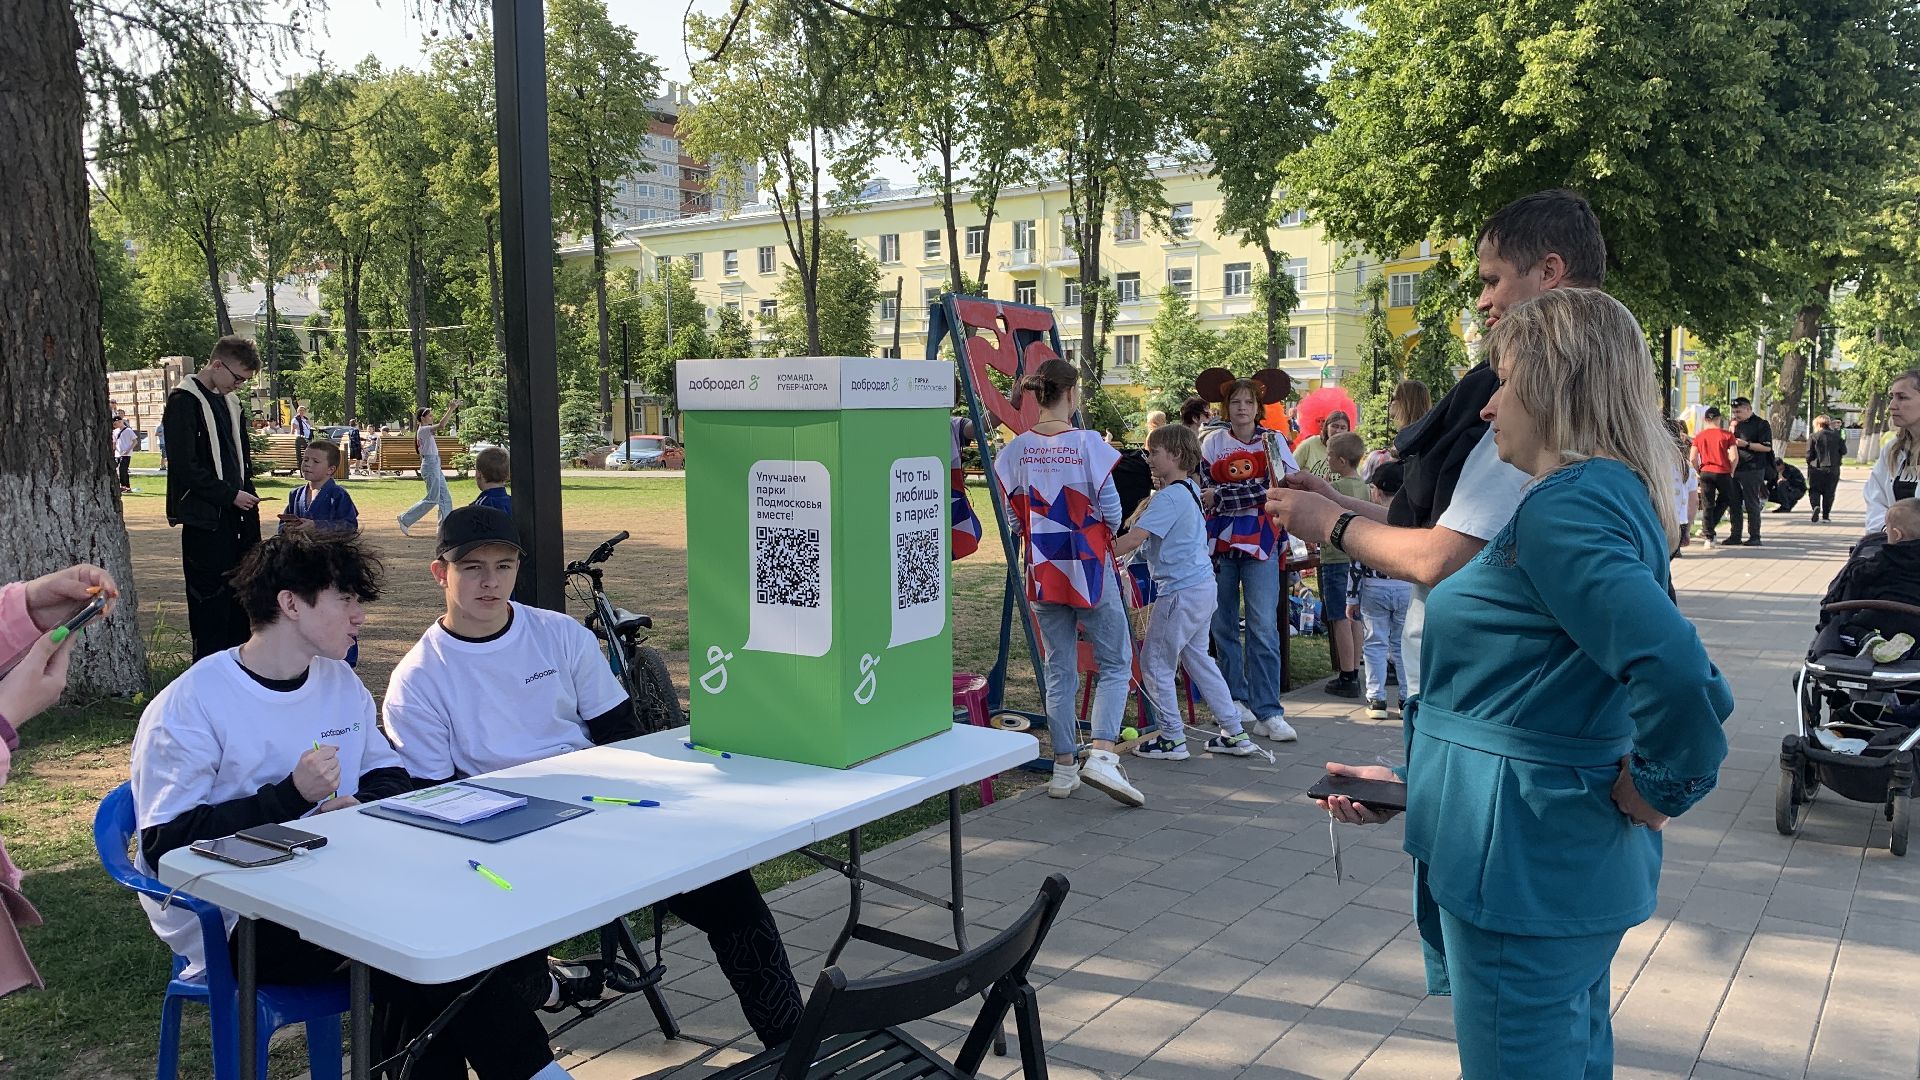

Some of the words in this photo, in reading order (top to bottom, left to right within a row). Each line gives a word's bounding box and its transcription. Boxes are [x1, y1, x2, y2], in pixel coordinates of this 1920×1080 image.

[688, 375, 745, 392] добродел
[777, 374, 814, 383] КОМАНДА
[851, 378, 891, 392] добродел
[777, 382, 828, 391] ГУБЕРНАТОРА
[756, 471, 806, 485] Улучшаем
[895, 469, 914, 483] Что
[916, 470, 931, 482] ты
[756, 485, 786, 496] парки
[895, 485, 939, 504] любишь
[756, 497, 822, 510] Подмосковья
[757, 510, 794, 521] вместе!
[896, 512, 902, 523] в
[903, 504, 939, 524] парке?
